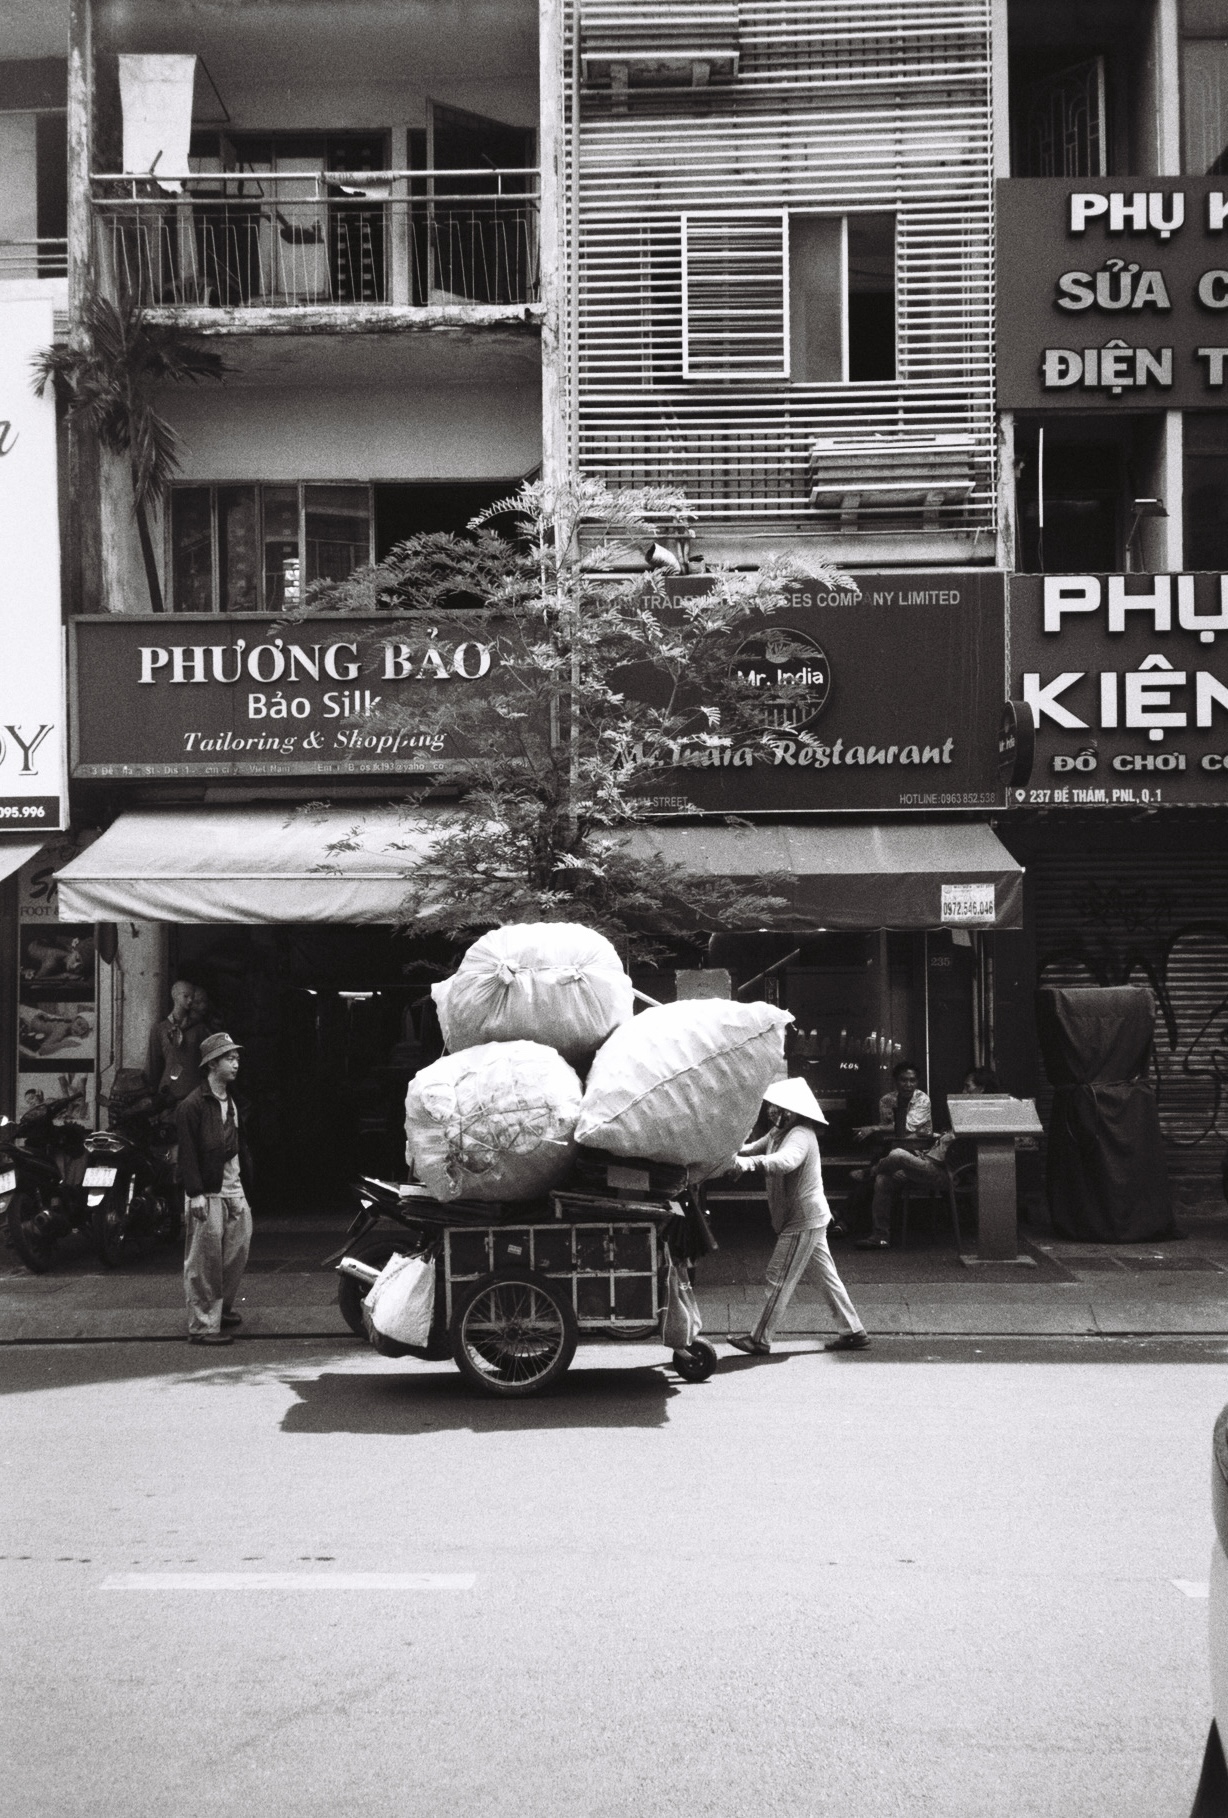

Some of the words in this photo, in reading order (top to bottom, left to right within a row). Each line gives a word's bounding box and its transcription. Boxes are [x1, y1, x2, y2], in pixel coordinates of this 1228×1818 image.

[1071, 192, 1185, 238] PHỤ
[1057, 259, 1171, 309] SỬA
[1042, 339, 1173, 393] ĐIỆN
[899, 591, 960, 605] LIMITED
[1044, 575, 1228, 643] PHỤ
[138, 638, 362, 684] PHƯƠNG
[381, 627, 491, 680] BẢO
[737, 669, 769, 686] Mr.
[777, 667, 824, 685] India
[248, 691, 311, 719] Bảo
[323, 690, 382, 718] Silk
[183, 732, 297, 754] Tailoring
[302, 731, 324, 749] &
[774, 738, 954, 768] Restaurant
[1113, 752, 1186, 770] CHƠI
[1201, 755, 1228, 770] C
[653, 796, 688, 807] STREET
[1030, 789, 1051, 803] 237
[1072, 786, 1109, 804] THÁM,
[1112, 789, 1139, 804] PNL,
[21, 906, 51, 917] FOOT
